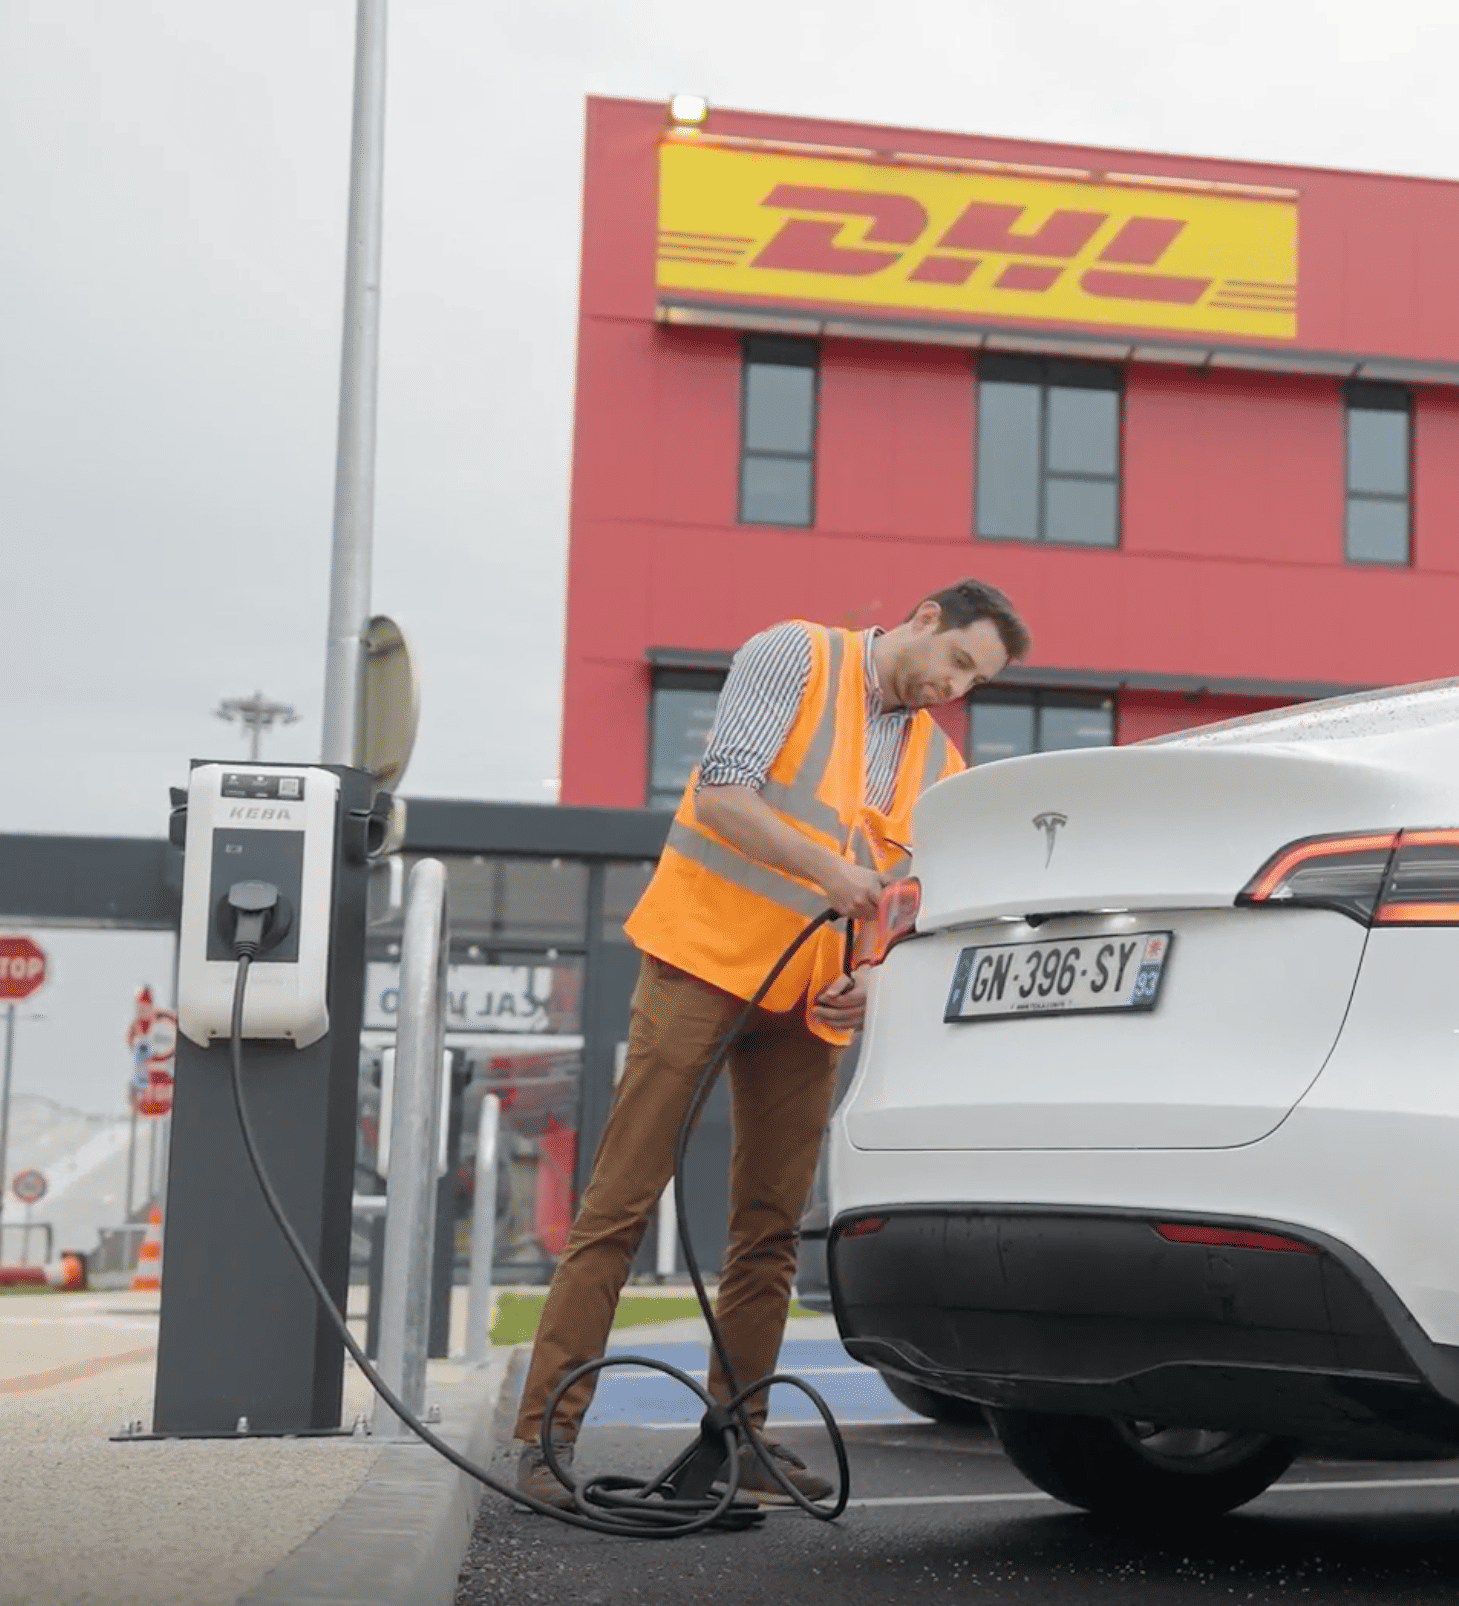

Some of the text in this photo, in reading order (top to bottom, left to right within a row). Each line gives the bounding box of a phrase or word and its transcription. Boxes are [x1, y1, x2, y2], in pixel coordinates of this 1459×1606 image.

[749, 182, 1214, 305] DHL
[229, 806, 291, 820] KEBA
[0, 956, 43, 979] TOP
[971, 941, 1137, 1004] GN-396-SY
